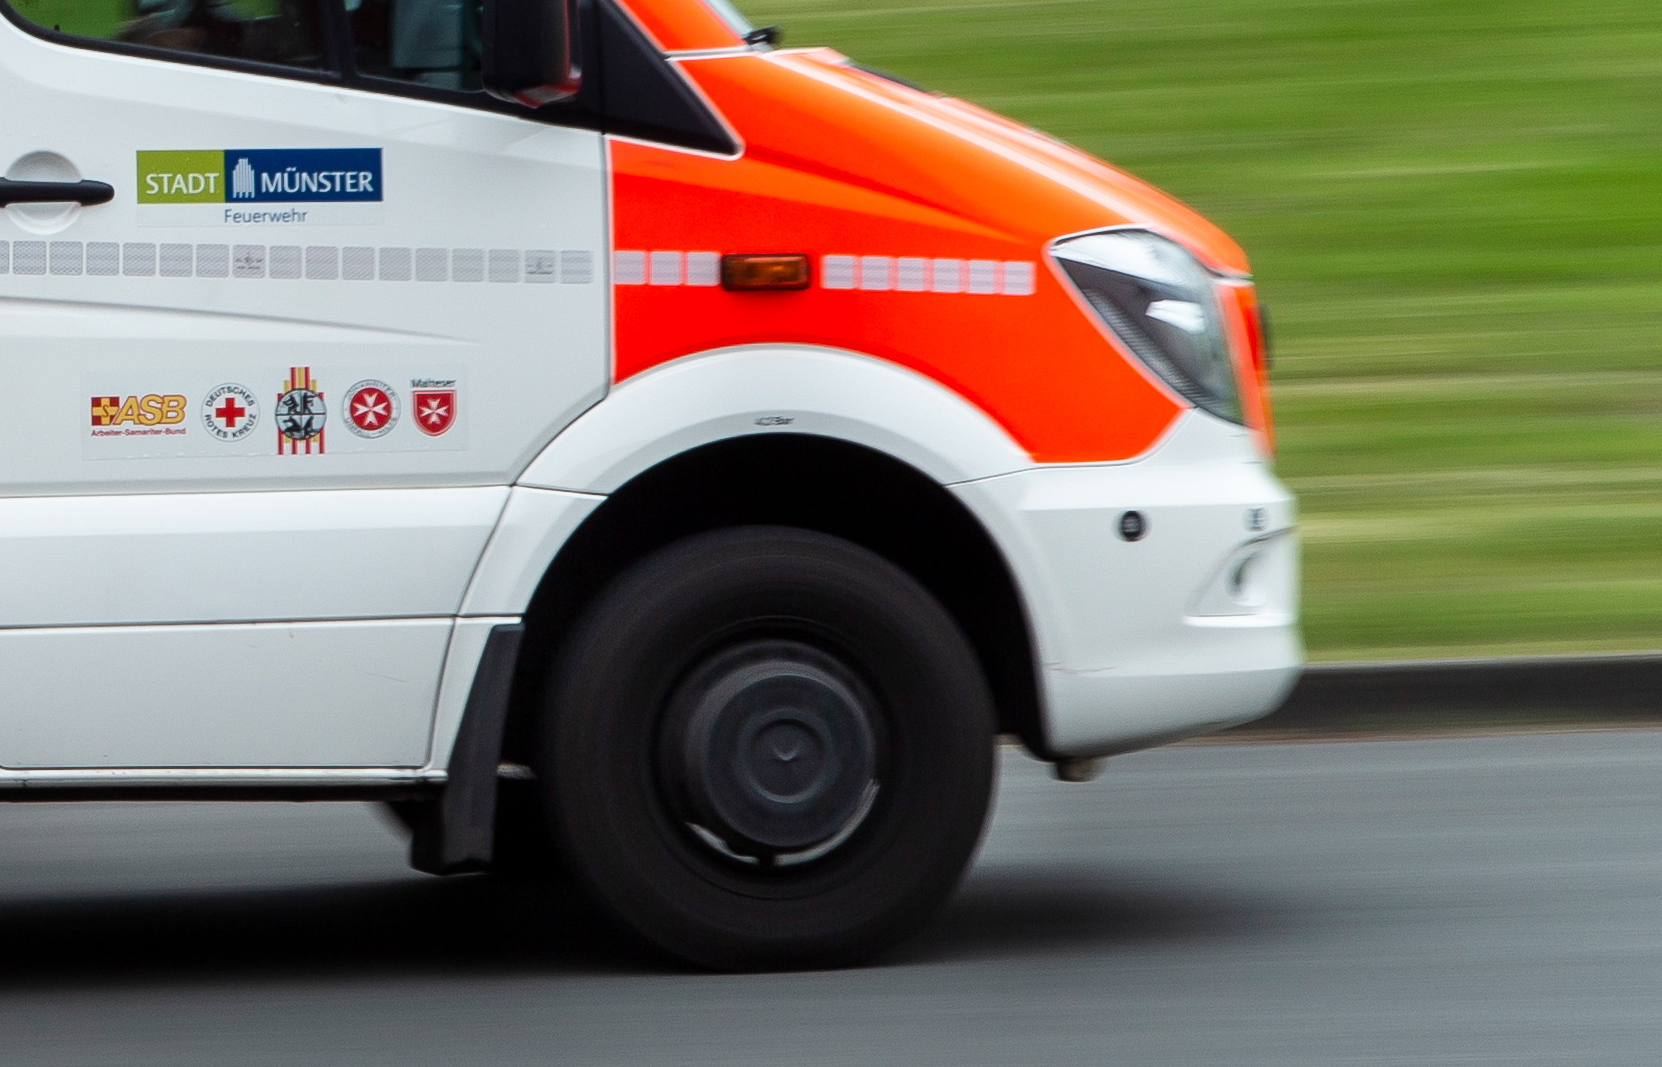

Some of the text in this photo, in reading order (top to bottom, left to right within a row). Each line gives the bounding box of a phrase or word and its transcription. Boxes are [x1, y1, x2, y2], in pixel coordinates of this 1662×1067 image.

[145, 167, 374, 195] STADT MÜNSTER
[224, 208, 308, 224] Feuerwehr
[205, 385, 256, 408] DEUTSCHES
[113, 394, 187, 426] ASB
[204, 413, 257, 439] ROTES KREUZ
